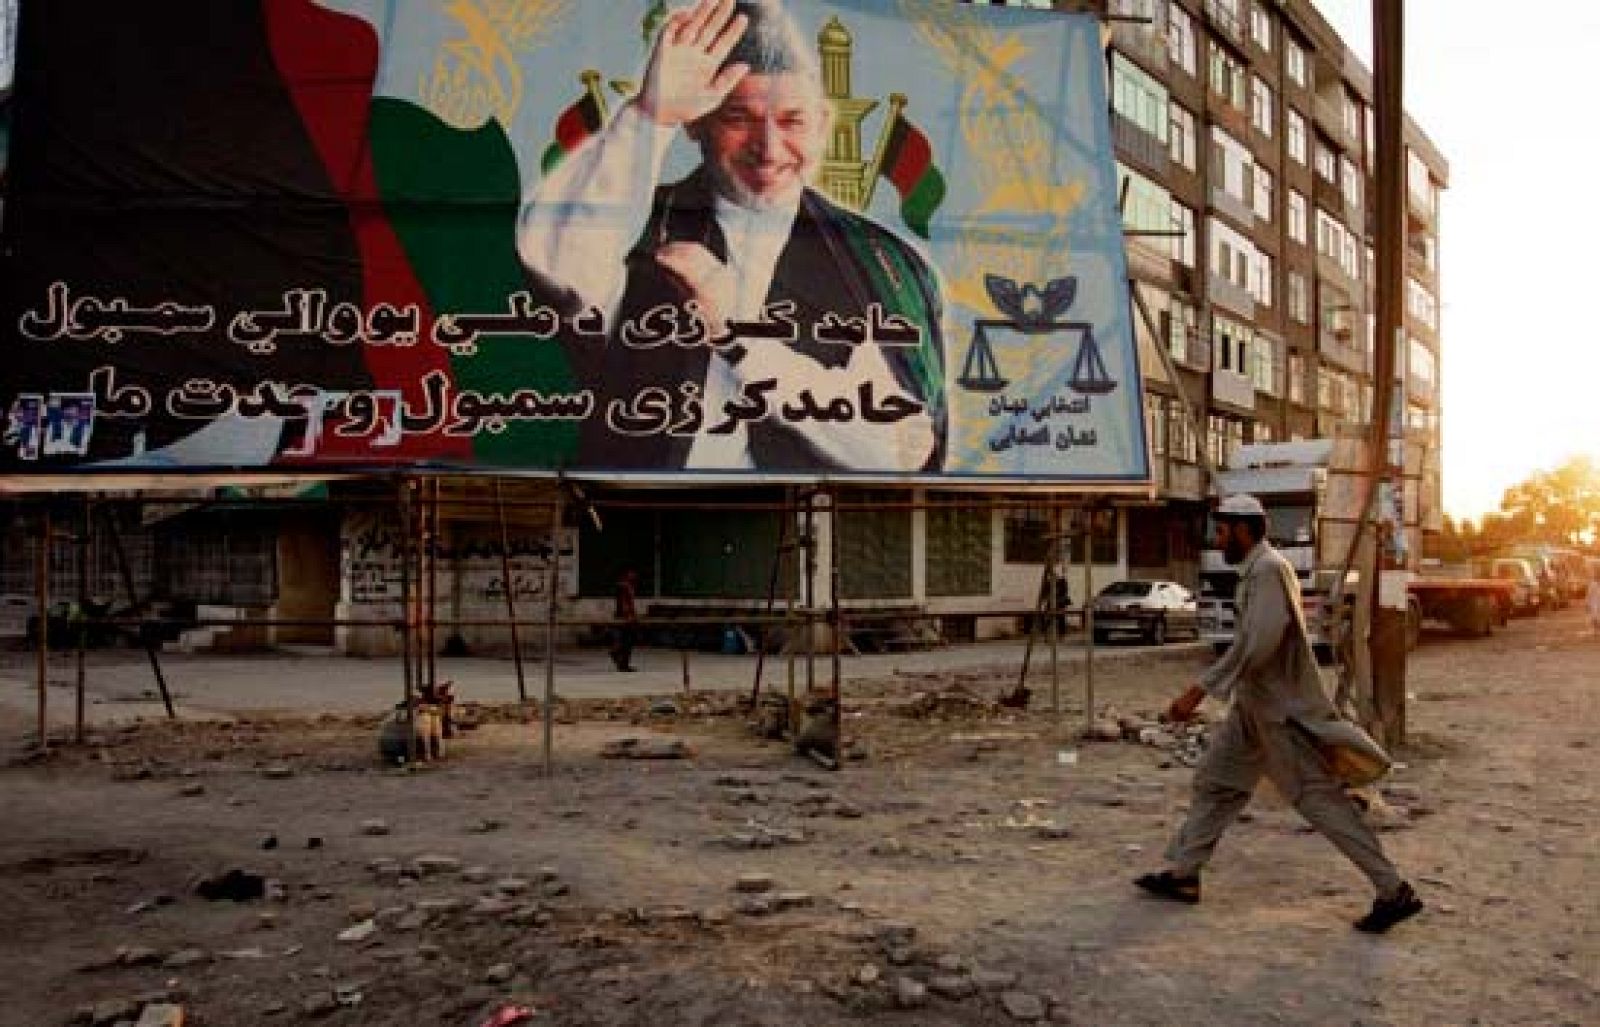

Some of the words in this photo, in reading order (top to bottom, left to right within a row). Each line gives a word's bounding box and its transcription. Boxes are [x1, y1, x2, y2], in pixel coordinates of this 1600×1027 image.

[19, 281, 217, 342] سمبول
[572, 306, 606, 336] د
[812, 301, 922, 344] حامد
[400, 368, 593, 436] سمبول
[781, 379, 925, 424] حامد
